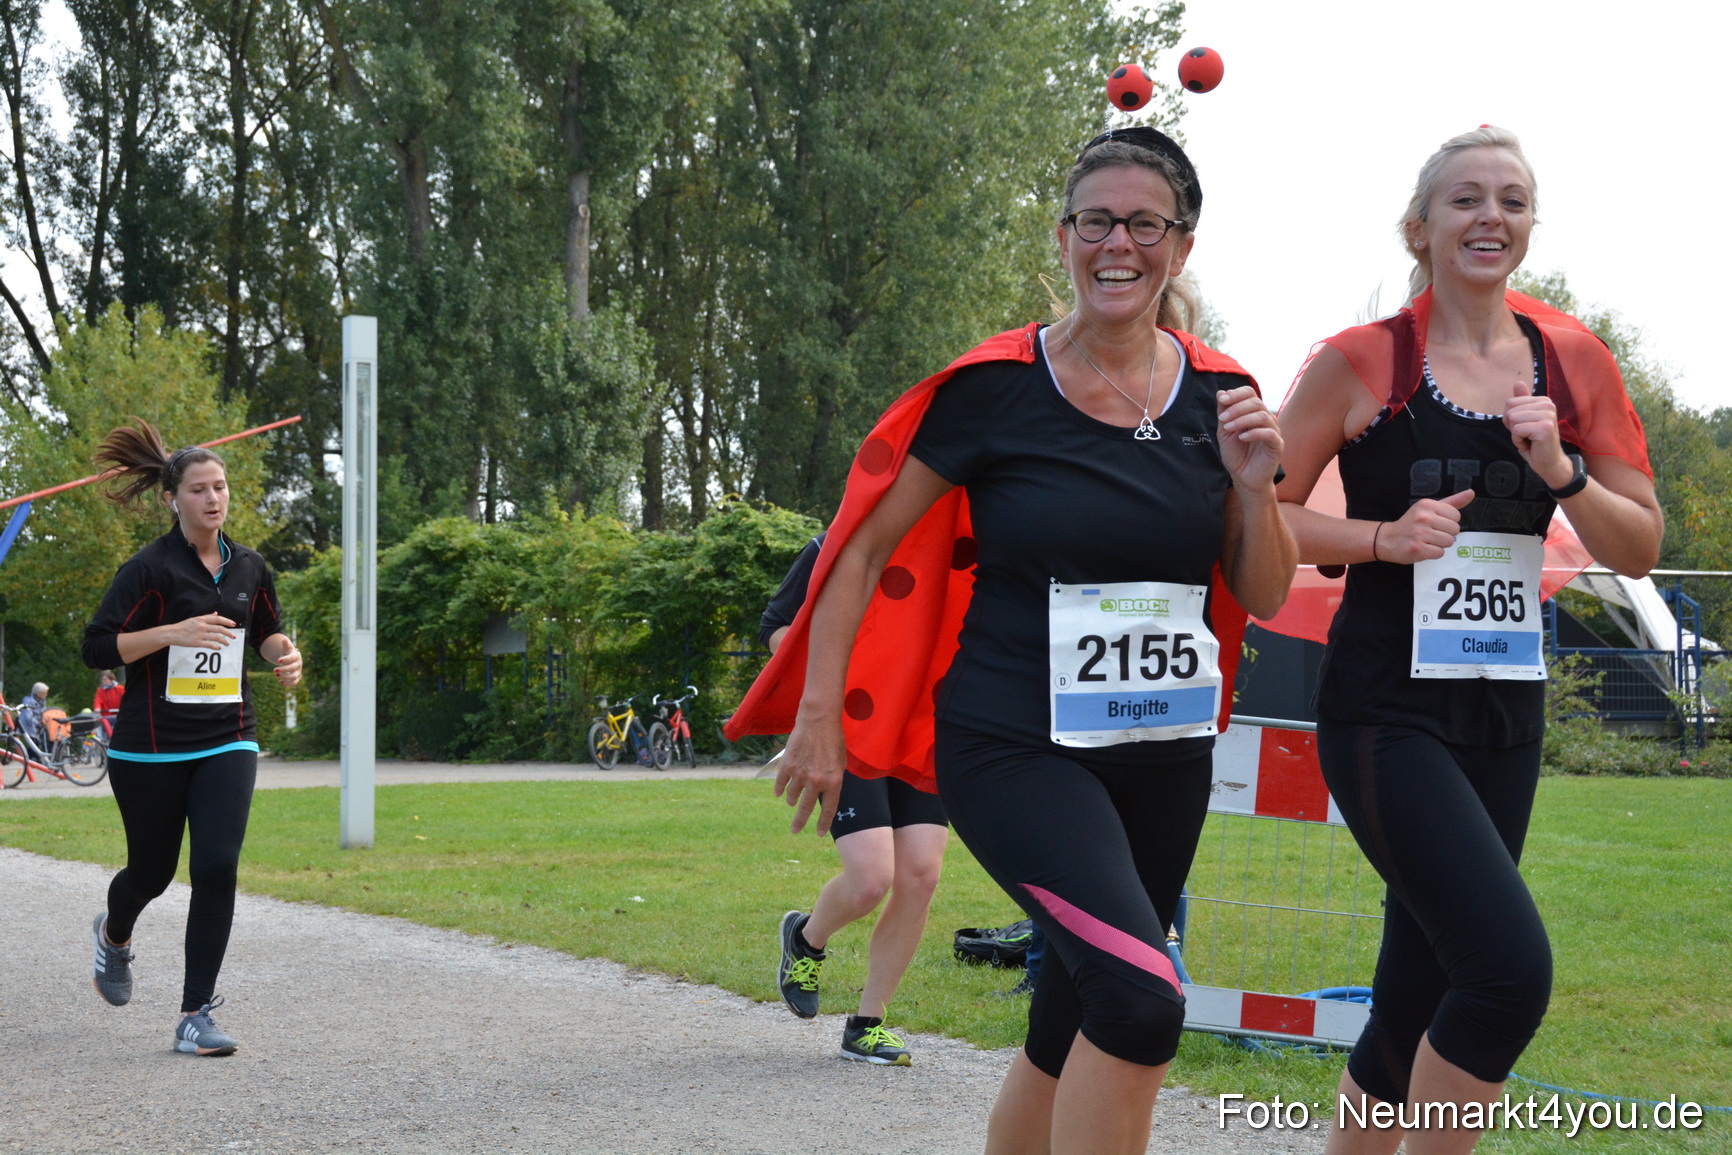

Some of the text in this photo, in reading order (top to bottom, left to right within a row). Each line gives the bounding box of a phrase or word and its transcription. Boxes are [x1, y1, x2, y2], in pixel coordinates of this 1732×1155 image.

[1473, 546, 1512, 560] BOCK
[1118, 599, 1170, 612] BOCK
[1437, 577, 1526, 623] 2565
[1423, 615, 1428, 623] D
[1462, 637, 1508, 653] Claudia
[194, 651, 222, 674] 20
[1077, 633, 1199, 682] 2155
[197, 682, 216, 690] Aline
[1060, 677, 1066, 686] D
[1107, 700, 1169, 720] Brigitte
